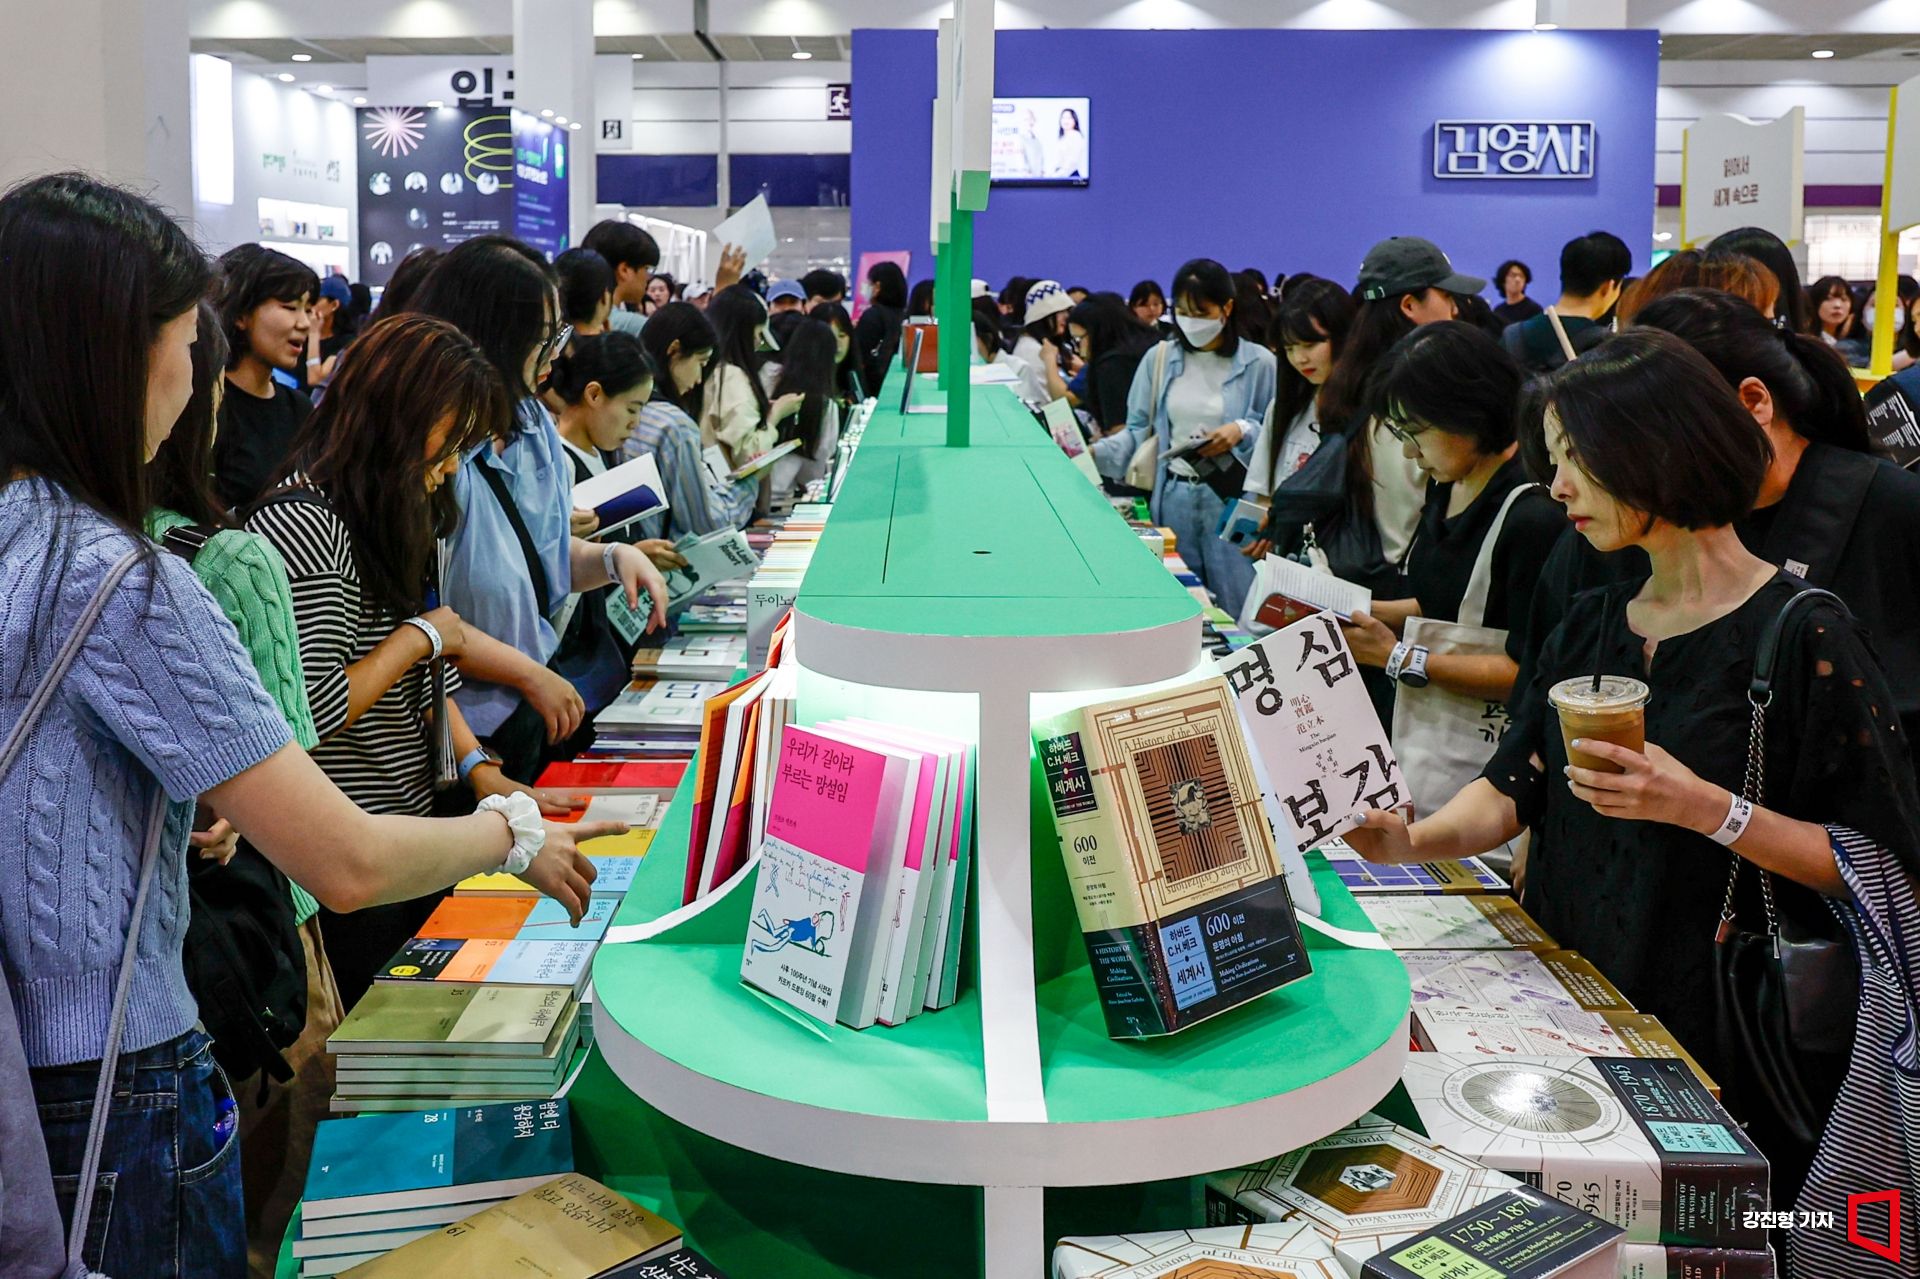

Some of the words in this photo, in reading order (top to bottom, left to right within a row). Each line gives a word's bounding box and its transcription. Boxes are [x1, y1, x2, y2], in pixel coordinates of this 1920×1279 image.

[451, 68, 514, 107] 입
[1442, 124, 1586, 172] 김영사
[1724, 155, 1750, 177] 읽어서
[1713, 187, 1729, 207] 세계
[1732, 184, 1759, 205] 속으로
[719, 544, 742, 566] Resort
[736, 548, 753, 566] Last
[755, 594, 797, 608] 두이노
[1048, 739, 1073, 753] 하버드
[1124, 741, 1131, 753] A
[1132, 735, 1165, 750] History
[1167, 729, 1176, 741] of
[1178, 727, 1191, 738] the
[1192, 721, 1218, 735] World
[787, 738, 818, 764] 우리가
[822, 749, 854, 776] 길이라
[1047, 752, 1080, 767] C.H.베크
[782, 764, 812, 790] 부르는
[816, 775, 848, 803] 망설임
[1055, 775, 1086, 795] 세계사
[1230, 782, 1241, 806] 600
[1074, 834, 1097, 853] 600
[1083, 855, 1096, 865] 이전
[1221, 861, 1252, 876] Making
[1167, 871, 1219, 894] Civilizations
[1169, 925, 1192, 941] 하버드
[1206, 912, 1230, 937] 600
[1232, 913, 1246, 925] 이전
[1100, 946, 1121, 954] HISTORY
[1167, 937, 1198, 957] C.H.베크
[1212, 938, 1231, 952] 문명의
[1231, 932, 1244, 944] 아침
[1110, 955, 1132, 963] WORLD
[781, 963, 789, 973] 사후
[790, 968, 808, 984] 100주년
[808, 977, 817, 988] 기념
[1177, 961, 1206, 985] 세계사
[778, 976, 791, 988] 카프카
[791, 983, 804, 996] 드로잉
[817, 996, 829, 1008] 수록!
[1610, 1064, 1663, 1118] 1870~1945
[424, 1113, 438, 1123] 28
[513, 1104, 535, 1138] 용감하지
[539, 1101, 560, 1119] 밤엔
[540, 1120, 560, 1130] 더
[1322, 1137, 1344, 1147] the
[1346, 1133, 1385, 1146] World
[1655, 1128, 1674, 1145] 하버드
[1693, 1127, 1718, 1149] 세계사
[1615, 1178, 1621, 1190] 세계
[1679, 1182, 1685, 1192] OF
[558, 1178, 585, 1196] 나는
[586, 1192, 618, 1211] 나의
[611, 1208, 645, 1228] 삶을
[1582, 1182, 1600, 1213] 945
[533, 1189, 562, 1205] 살고
[560, 1202, 617, 1234] 있습니다
[1449, 1199, 1541, 1245] 1750~1870
[446, 1227, 466, 1237] 61
[1471, 1241, 1488, 1252] 근대
[1487, 1231, 1511, 1246] 세계로
[1525, 1219, 1536, 1230] 길
[1529, 1239, 1547, 1250] Modern
[1546, 1231, 1562, 1242] World
[1146, 1252, 1194, 1275] History
[1201, 1247, 1218, 1257] of
[1221, 1249, 1246, 1261] the
[1251, 1254, 1300, 1270] World
[1405, 1243, 1437, 1259] 하버드
[1411, 1248, 1451, 1270] C.H.베크
[669, 1254, 698, 1277] 나는
